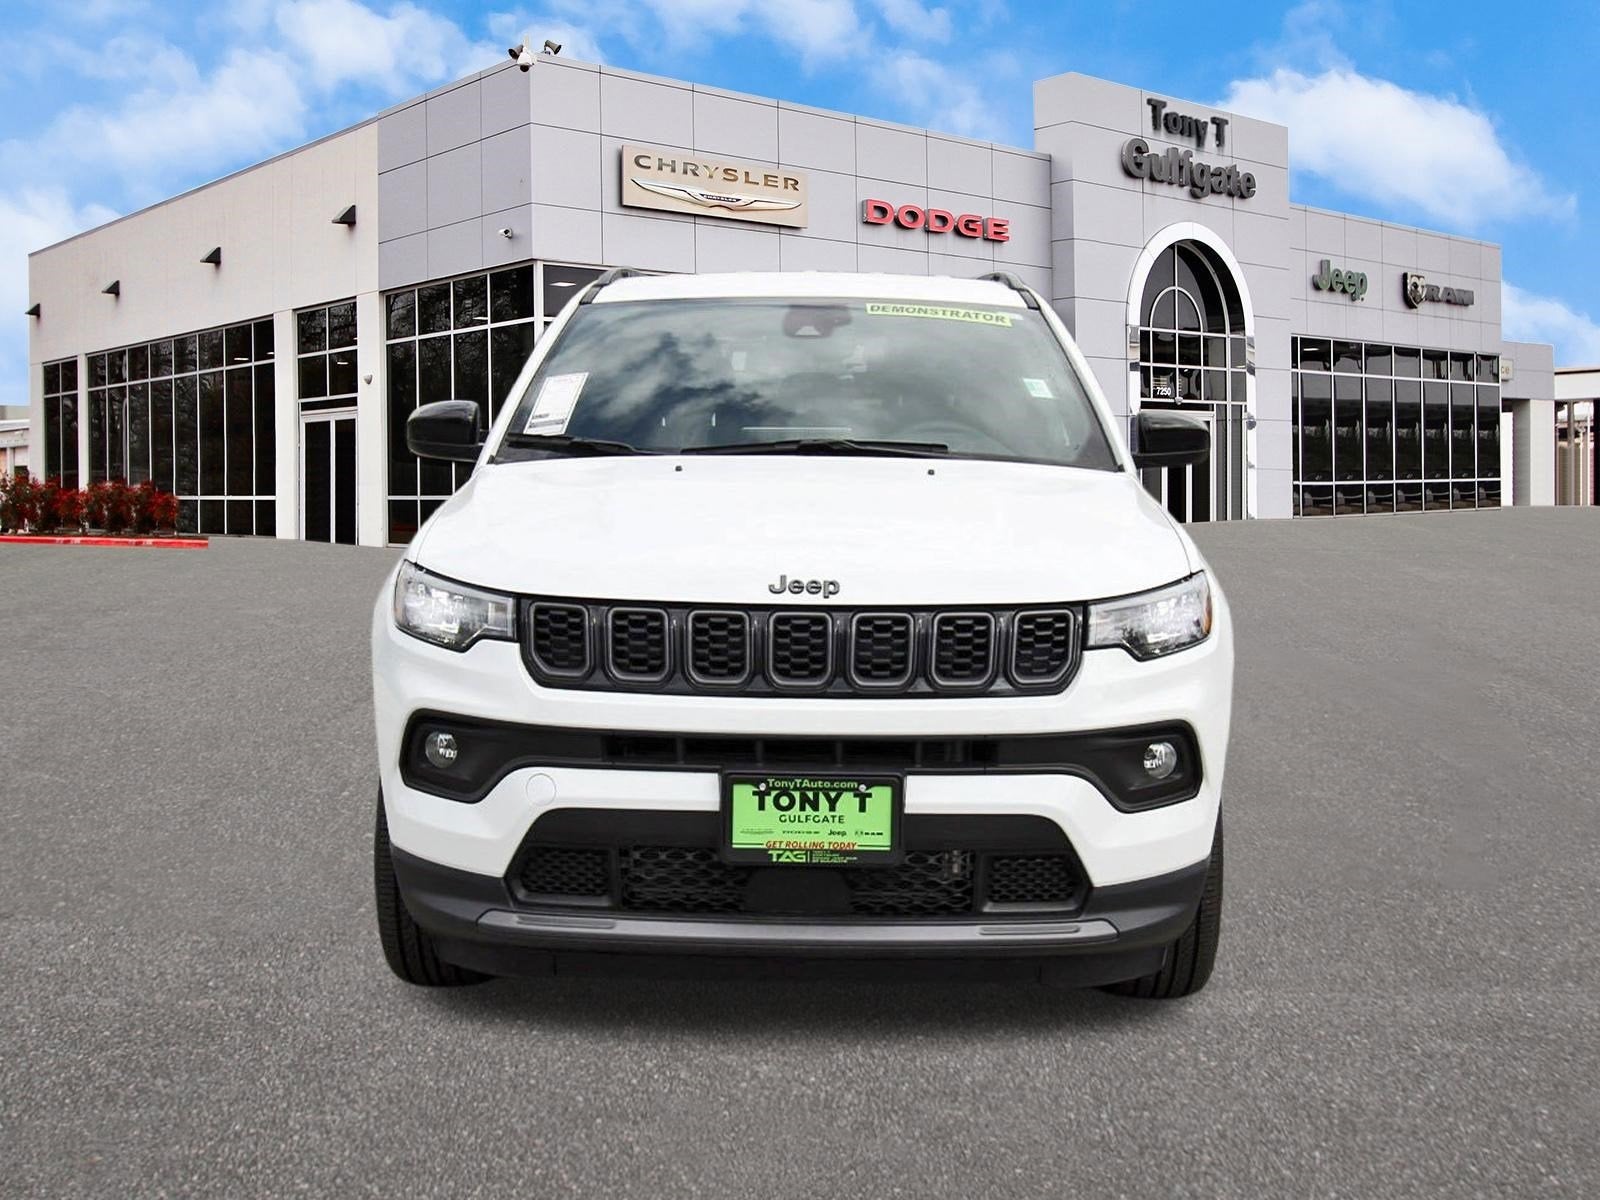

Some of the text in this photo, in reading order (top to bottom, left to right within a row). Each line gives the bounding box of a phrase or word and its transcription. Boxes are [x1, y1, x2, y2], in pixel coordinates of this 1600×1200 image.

[1146, 97, 1229, 148] Tony T
[633, 153, 801, 192] CHRYSLER
[1120, 137, 1257, 199] Gulfgate
[862, 198, 1011, 243] DODGE
[1312, 258, 1368, 302] Jeep
[1425, 283, 1475, 307] RAM
[870, 304, 1007, 324] DEMONSTRATOR
[768, 574, 841, 599] Jeep
[767, 778, 859, 790] TonyTAuto.com
[752, 789, 873, 814] TONY T
[779, 814, 845, 824] GULFGATE
[765, 840, 857, 850] GET ROLLING TODAY
[768, 850, 806, 863] TAG
